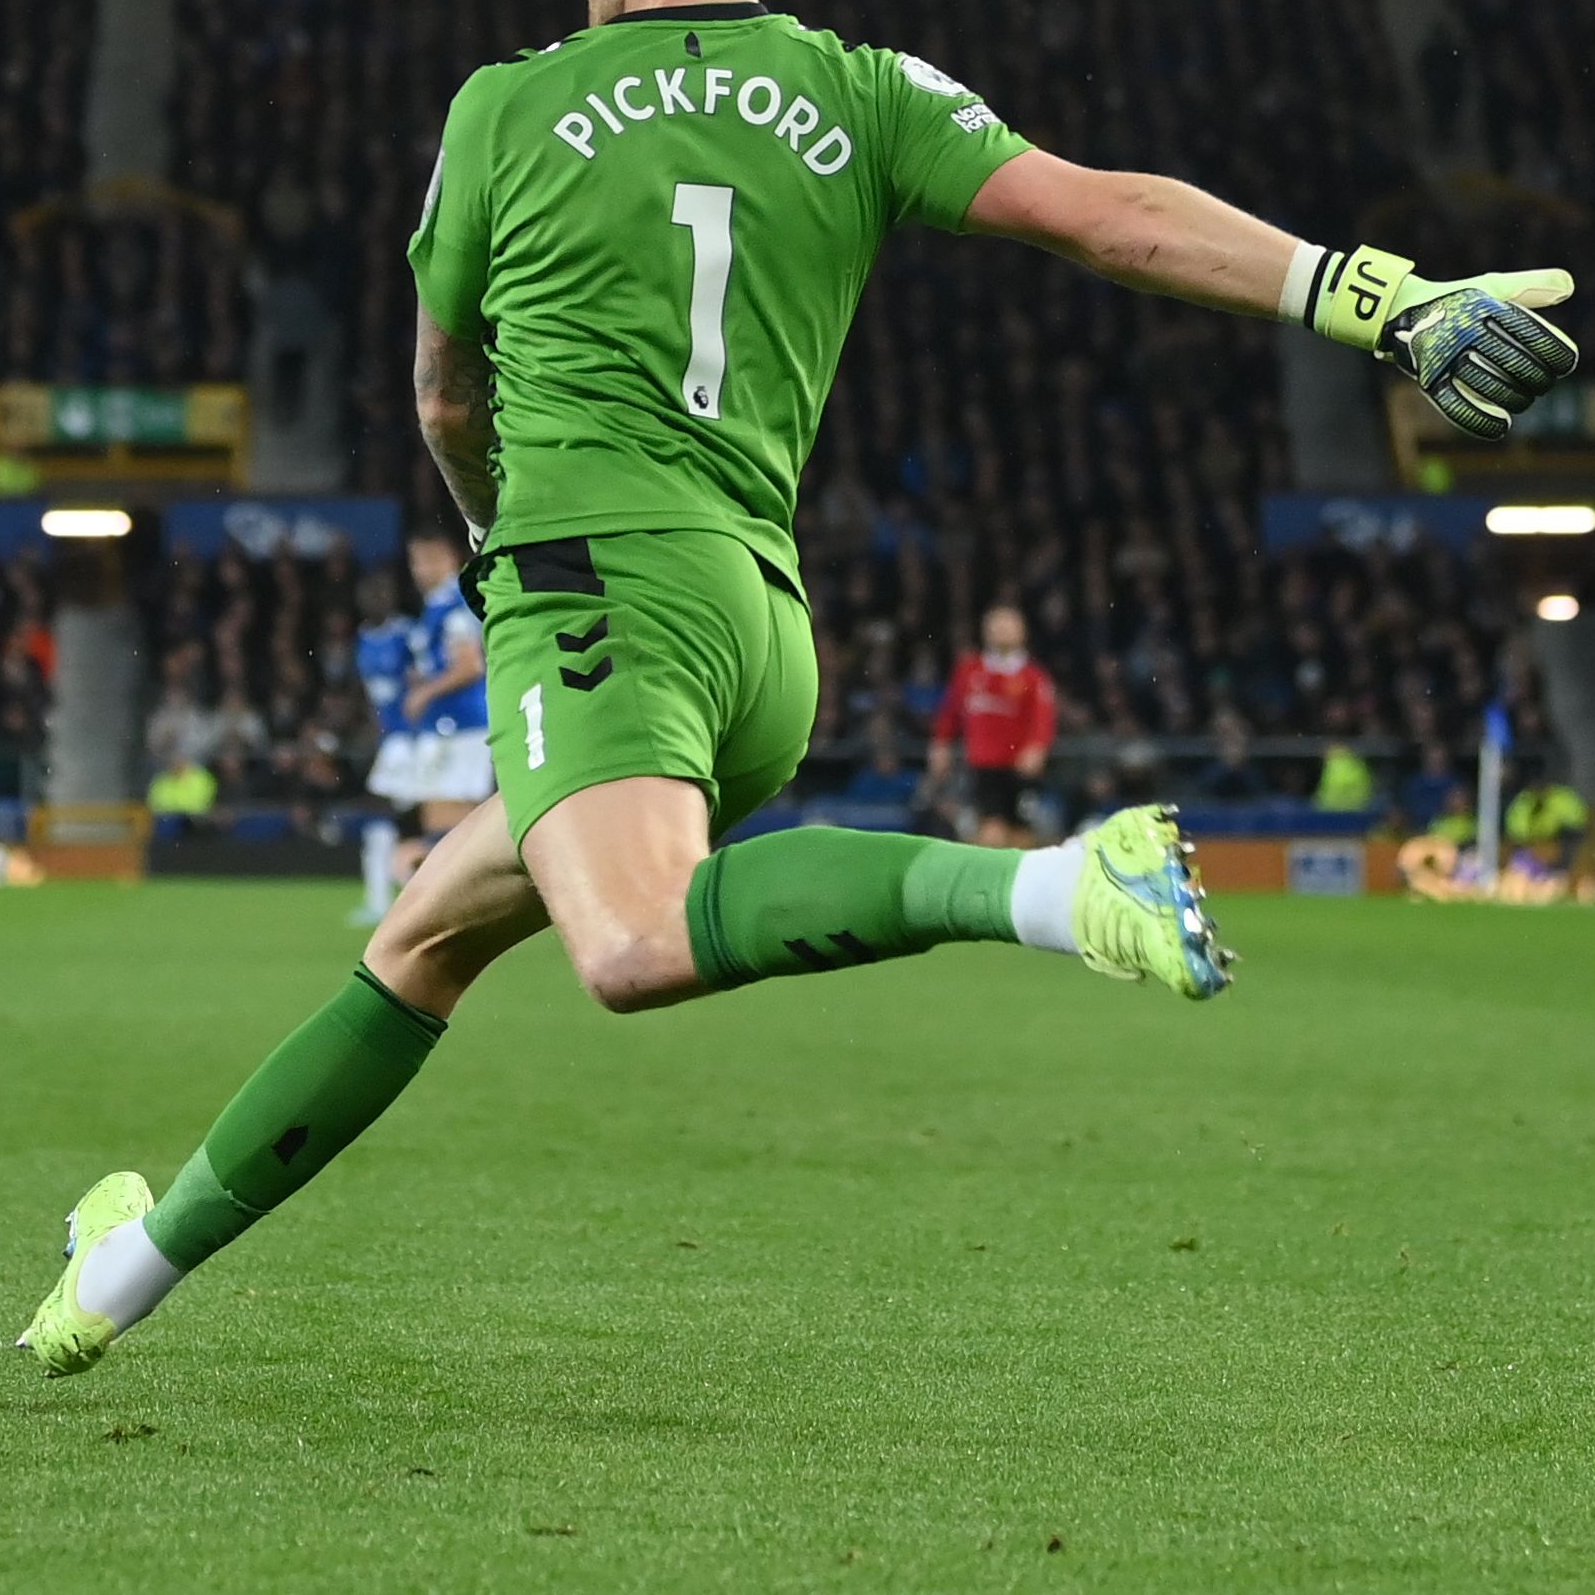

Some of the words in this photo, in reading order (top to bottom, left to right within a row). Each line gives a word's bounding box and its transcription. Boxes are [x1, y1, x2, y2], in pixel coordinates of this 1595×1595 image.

[552, 66, 853, 176] PICKFORD
[671, 182, 735, 421] 1
[1347, 260, 1389, 321] JP
[517, 682, 546, 772] 1
